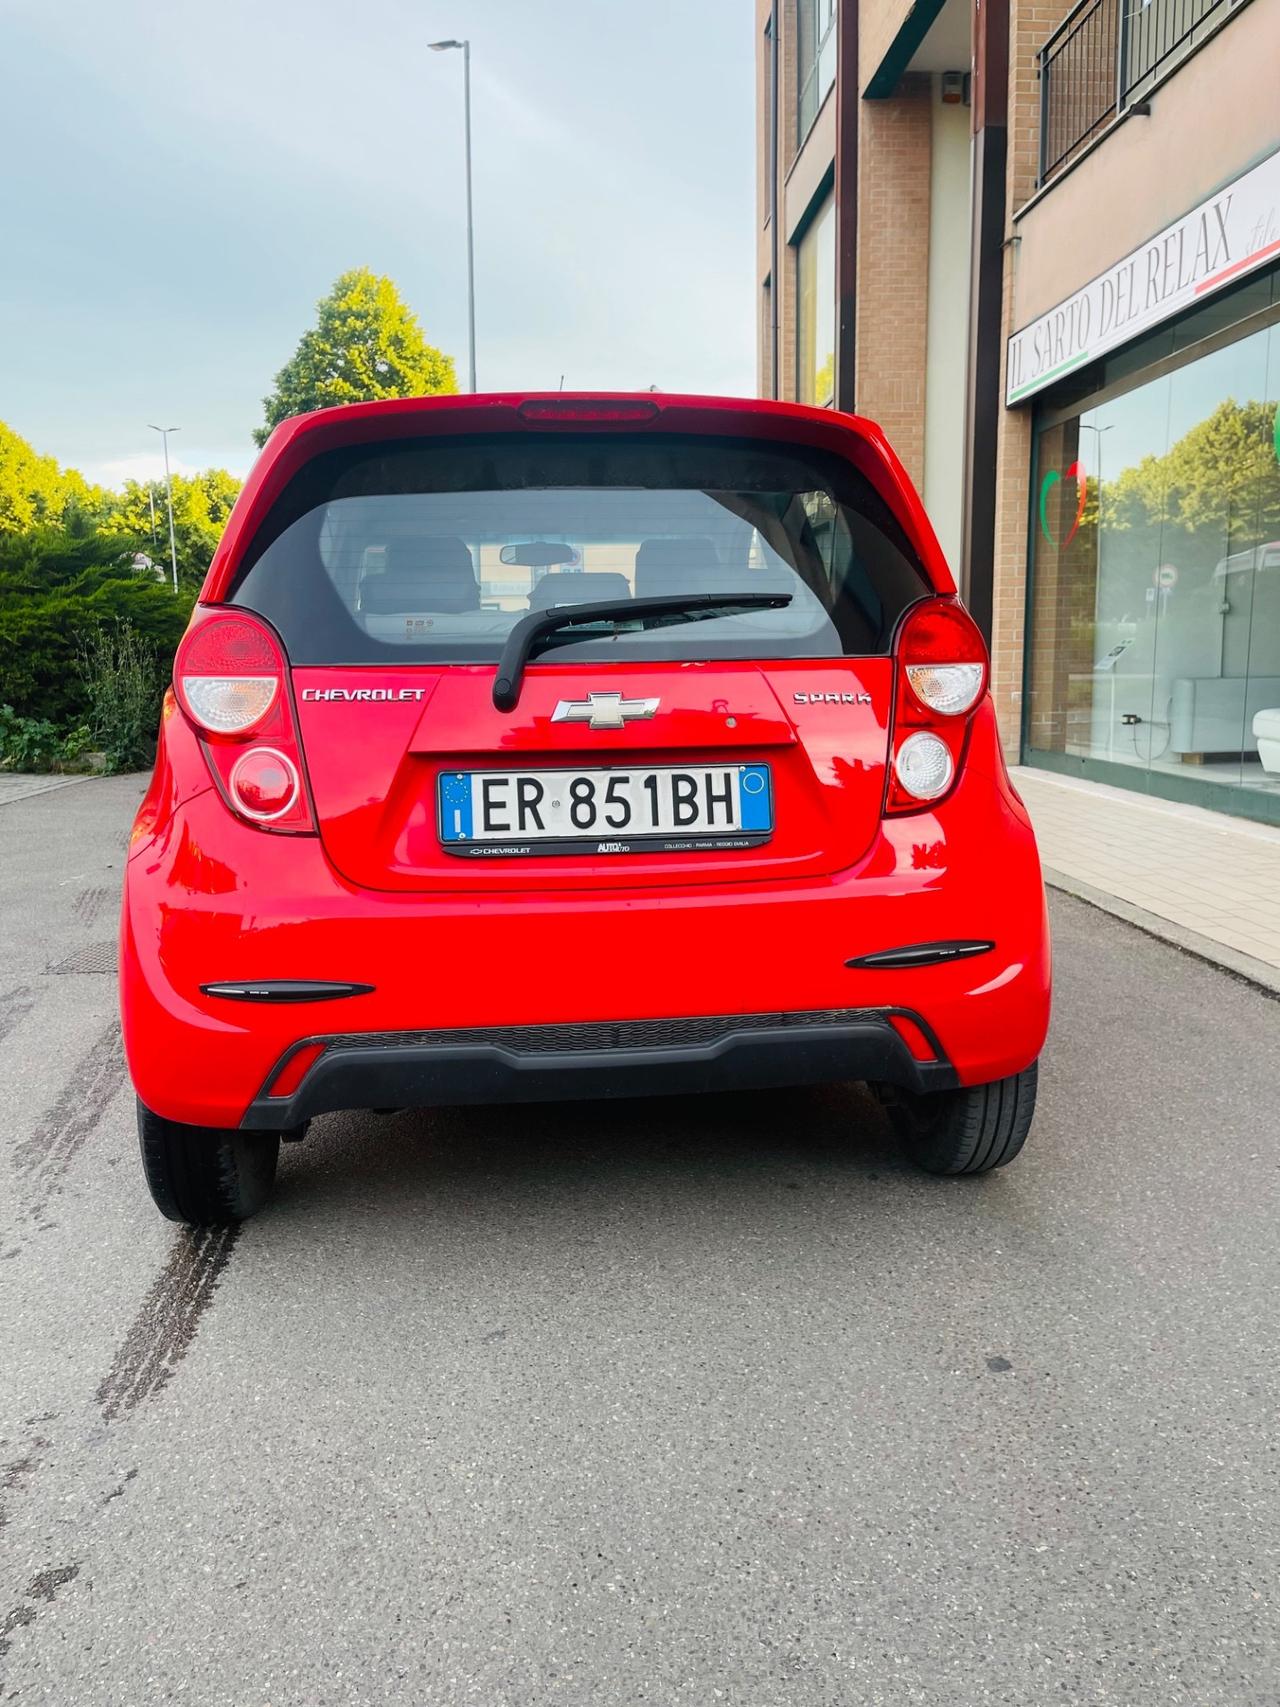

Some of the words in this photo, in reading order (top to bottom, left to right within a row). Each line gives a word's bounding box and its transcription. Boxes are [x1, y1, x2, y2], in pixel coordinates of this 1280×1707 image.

[1011, 340, 1025, 389] IL
[1032, 294, 1090, 377] SARTO
[1100, 261, 1141, 337] DEL
[1145, 194, 1233, 309] RELAX
[301, 688, 426, 702] CHEVROLET
[793, 692, 872, 705] SPARK
[482, 777, 546, 832] ER
[568, 772, 734, 830] 851BH
[483, 847, 531, 855] CHEVROLET
